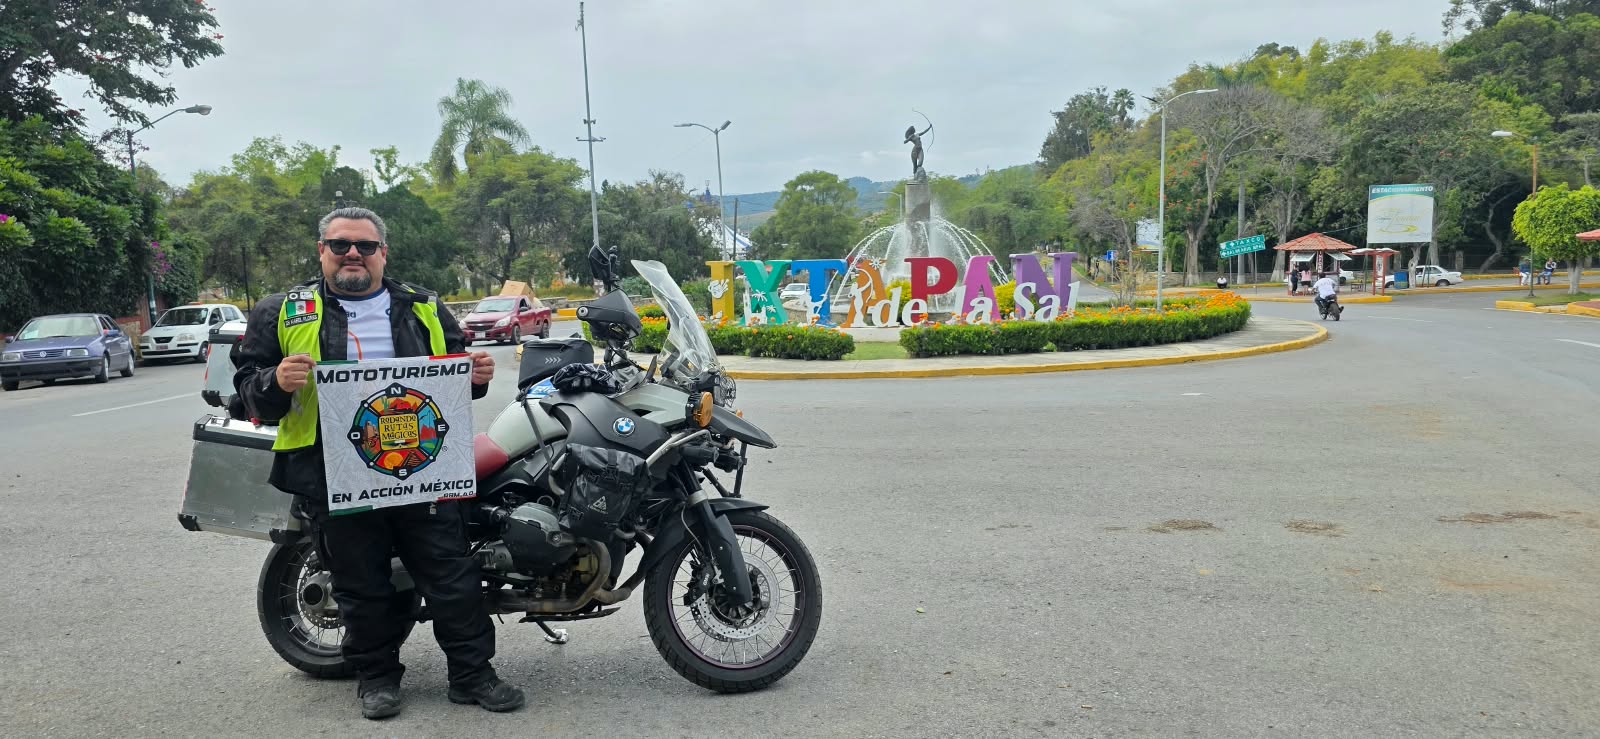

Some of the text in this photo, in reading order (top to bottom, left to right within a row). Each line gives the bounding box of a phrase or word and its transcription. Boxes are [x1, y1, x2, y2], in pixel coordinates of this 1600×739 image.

[1236, 237, 1261, 246] TAXCO
[705, 252, 1077, 328] IXTAPAN
[869, 281, 1080, 327] de la Sal
[316, 362, 470, 384] MOTOTURISMO
[332, 479, 474, 503] EN ACCIÓN MÉXICO
